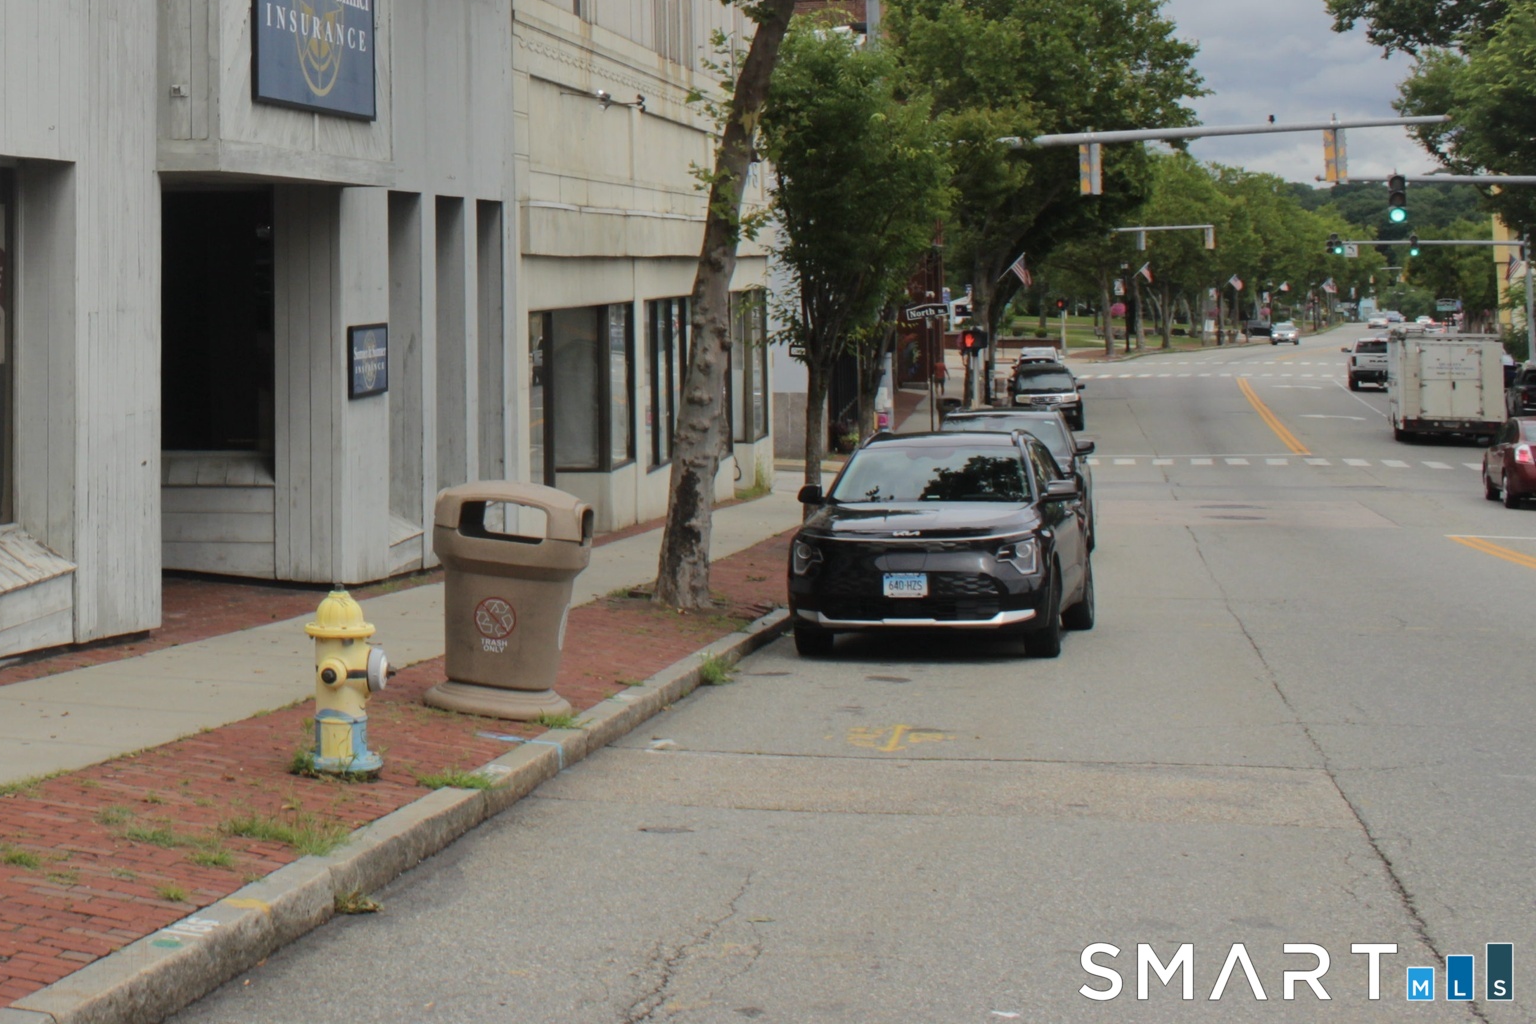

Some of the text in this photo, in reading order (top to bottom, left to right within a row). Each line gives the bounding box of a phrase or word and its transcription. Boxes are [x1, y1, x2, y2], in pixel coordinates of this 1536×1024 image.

[266, 2, 367, 53] INSURANCE
[909, 307, 936, 319] North
[481, 638, 508, 647] TRASH
[483, 644, 505, 653] ONLY
